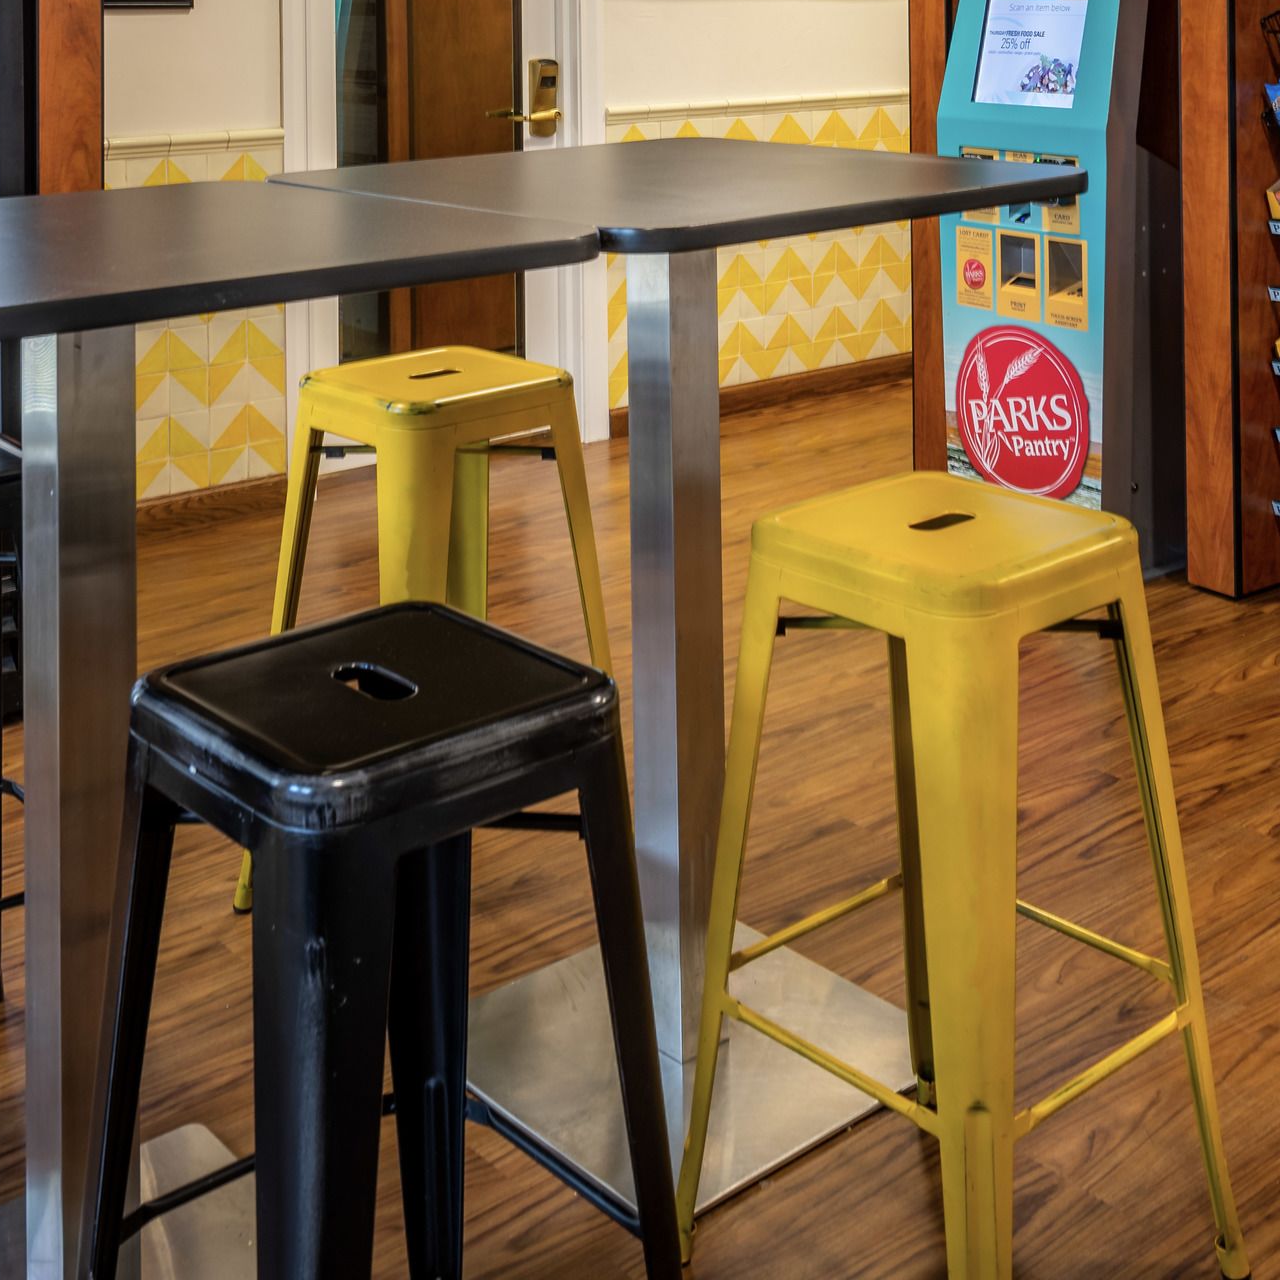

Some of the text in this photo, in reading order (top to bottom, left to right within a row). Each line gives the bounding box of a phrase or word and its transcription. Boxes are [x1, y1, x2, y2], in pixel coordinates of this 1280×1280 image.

[1051, 3, 1071, 12] below
[1001, 37, 1031, 49] 25% off
[969, 394, 1072, 434] PARKS
[1012, 435, 1070, 461] Pantry
